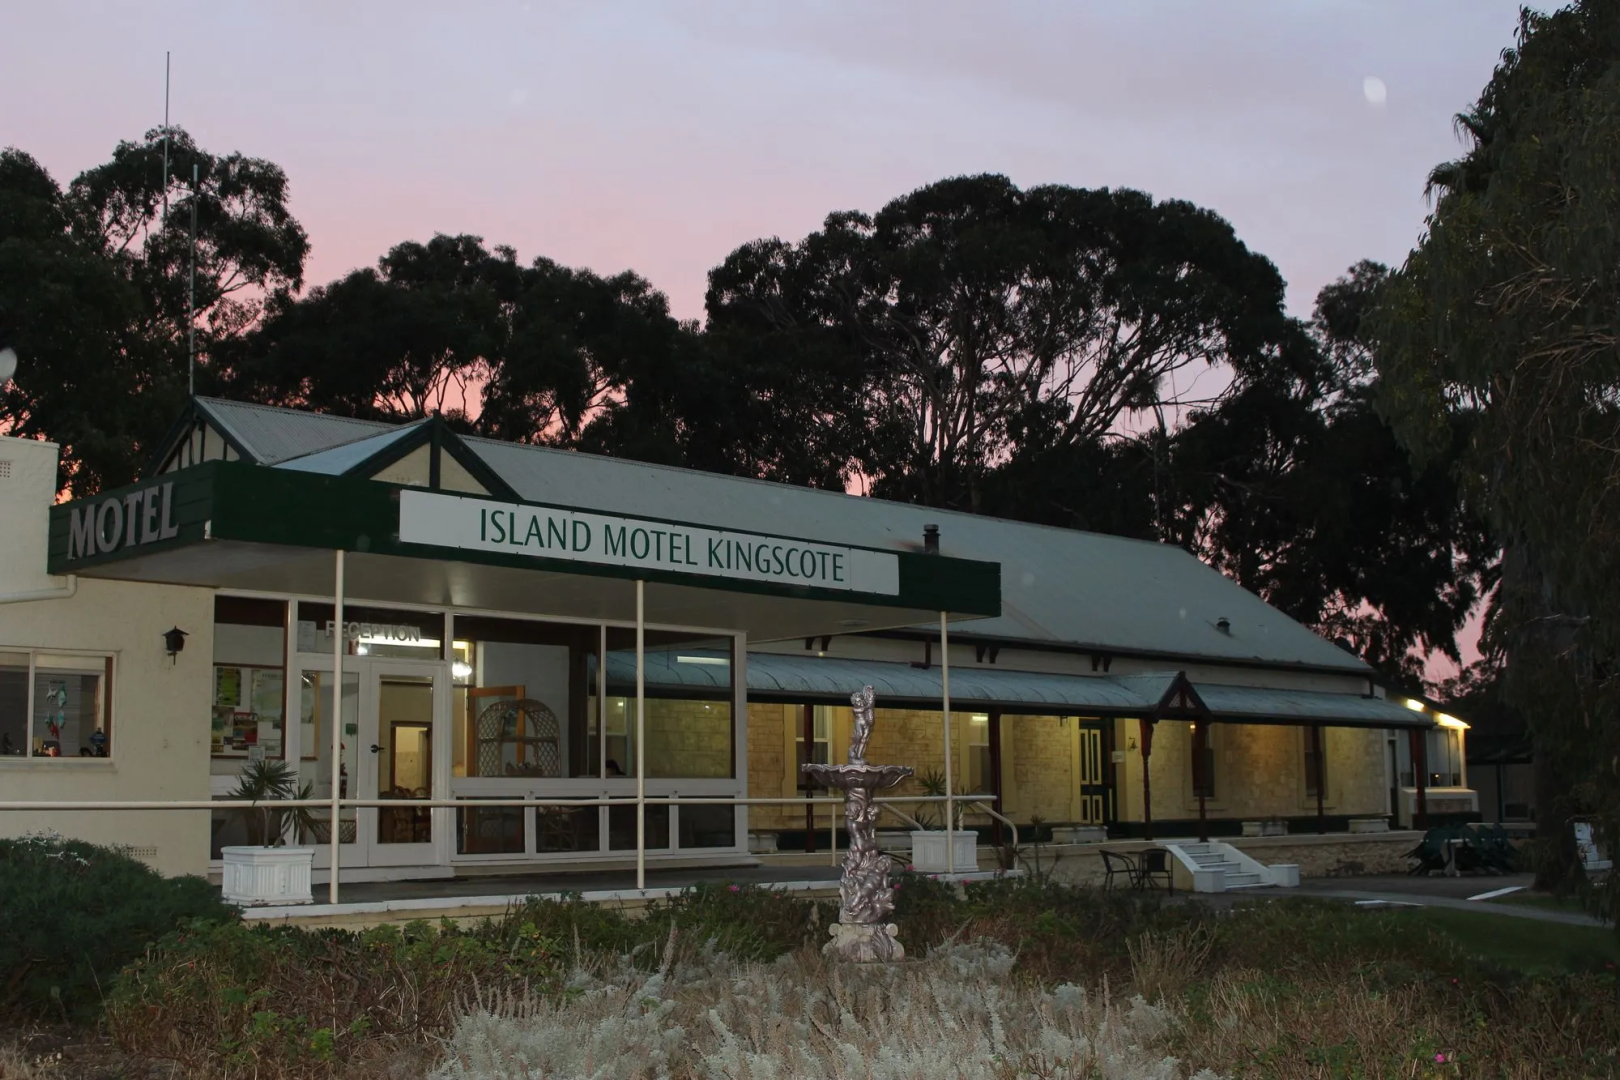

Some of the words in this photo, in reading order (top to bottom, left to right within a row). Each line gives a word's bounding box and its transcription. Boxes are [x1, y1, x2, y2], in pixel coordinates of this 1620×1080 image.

[66, 480, 179, 561] MOTEL
[480, 508, 592, 553] ISLAND
[604, 523, 698, 566] MOTEL
[708, 538, 845, 582] KINGSCOTE
